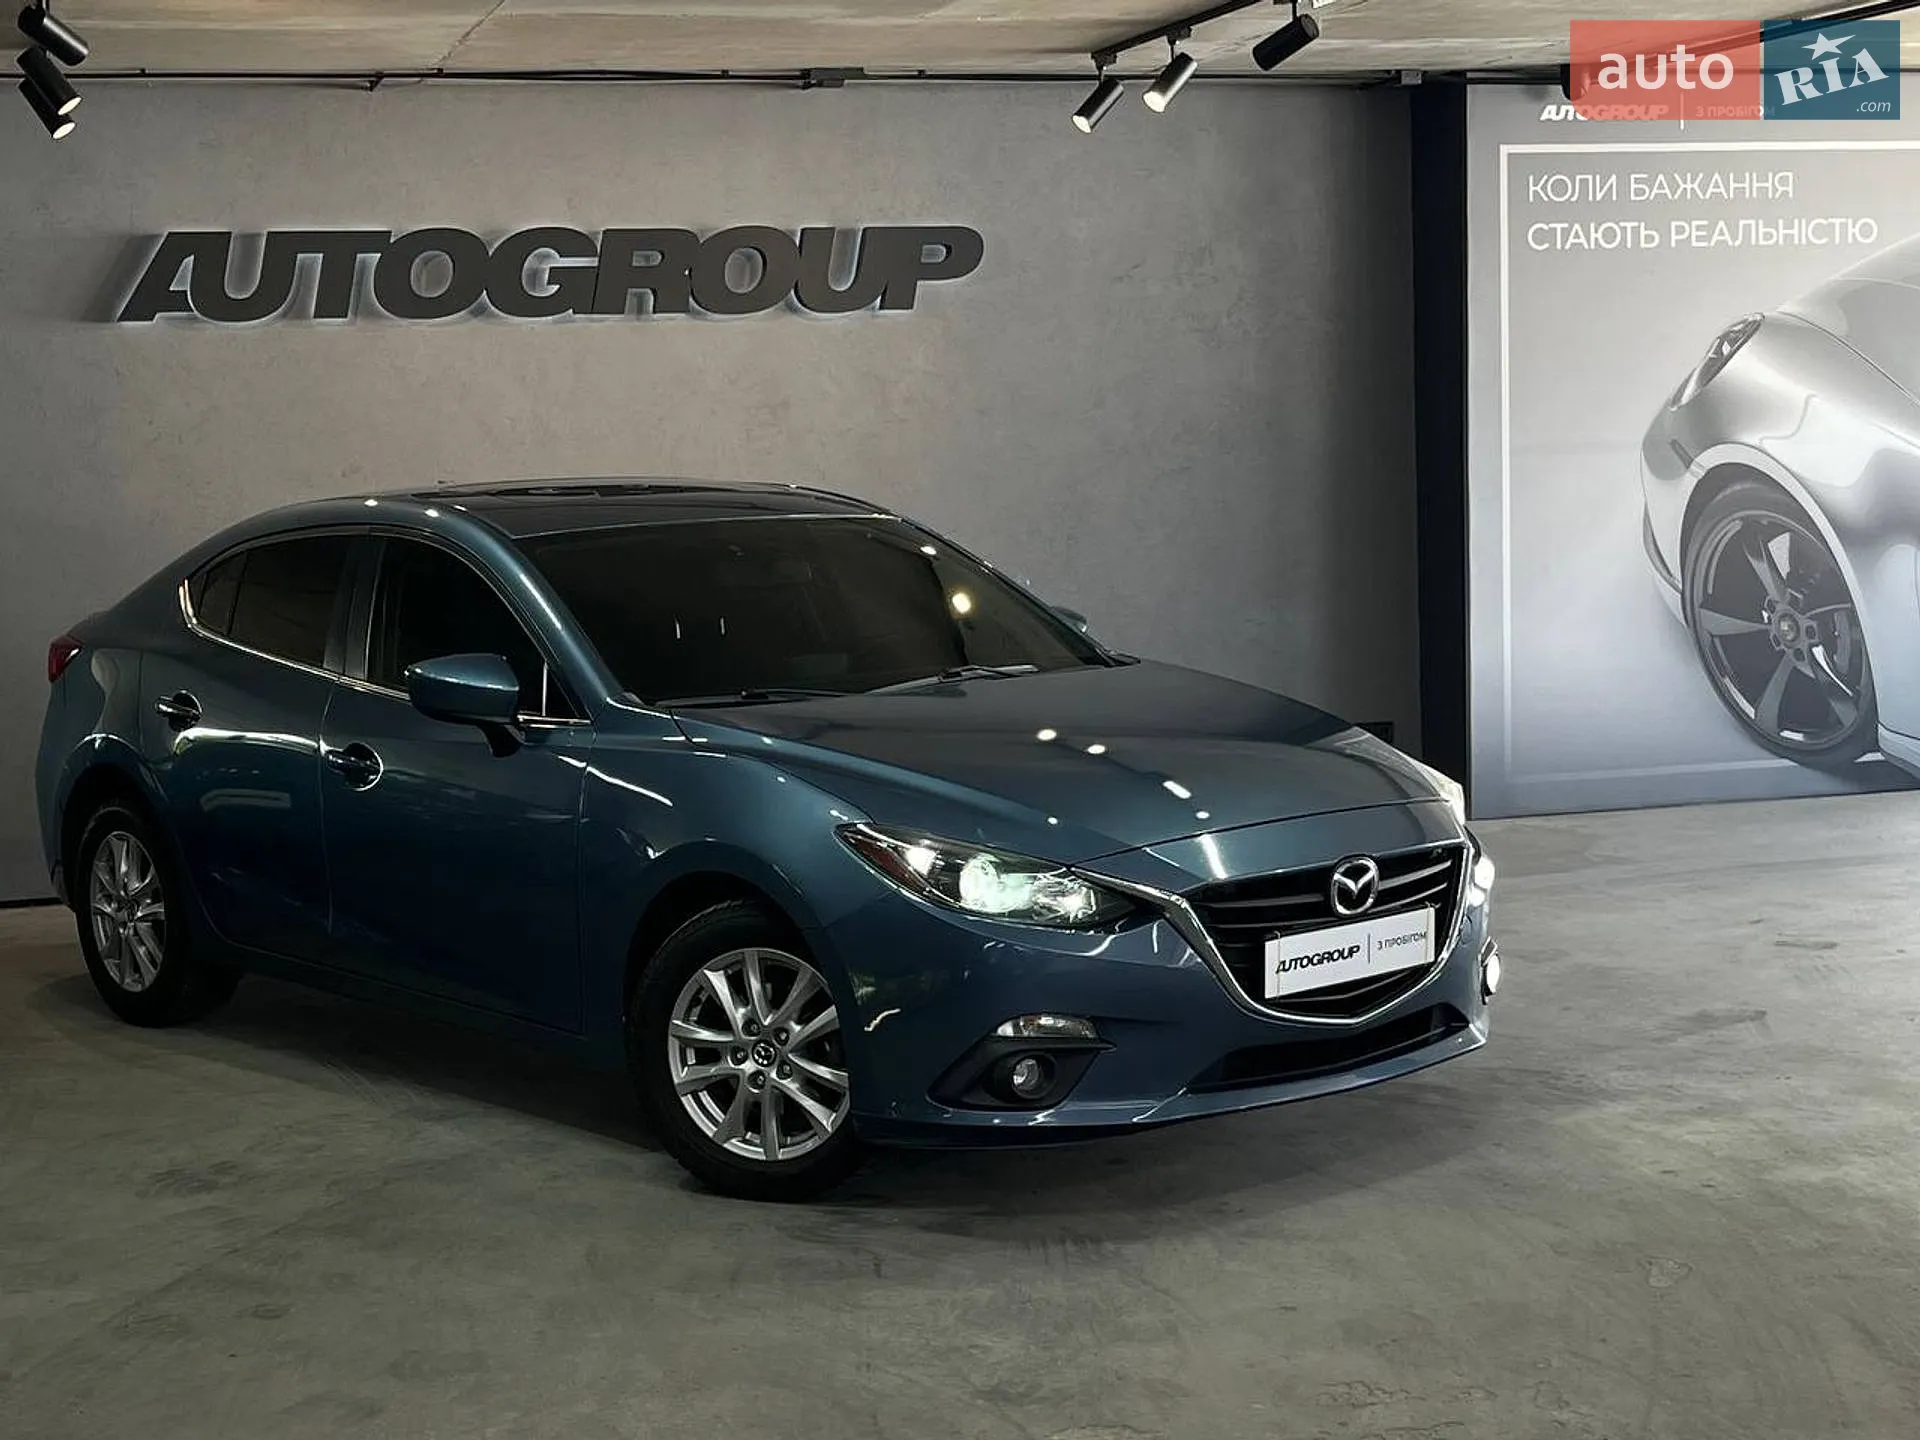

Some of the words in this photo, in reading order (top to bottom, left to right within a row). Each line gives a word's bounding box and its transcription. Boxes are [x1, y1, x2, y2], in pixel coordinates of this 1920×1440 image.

[1528, 173, 1618, 203] КОЛИ
[1630, 171, 1795, 201] БАЖАННЯ
[1527, 220, 1661, 251] СТАЮТЬ
[1670, 216, 1879, 249] РЕАЛЬНІСТЮ
[117, 225, 985, 323] AUTOGROUP
[1275, 944, 1361, 975] AUTOGROUP
